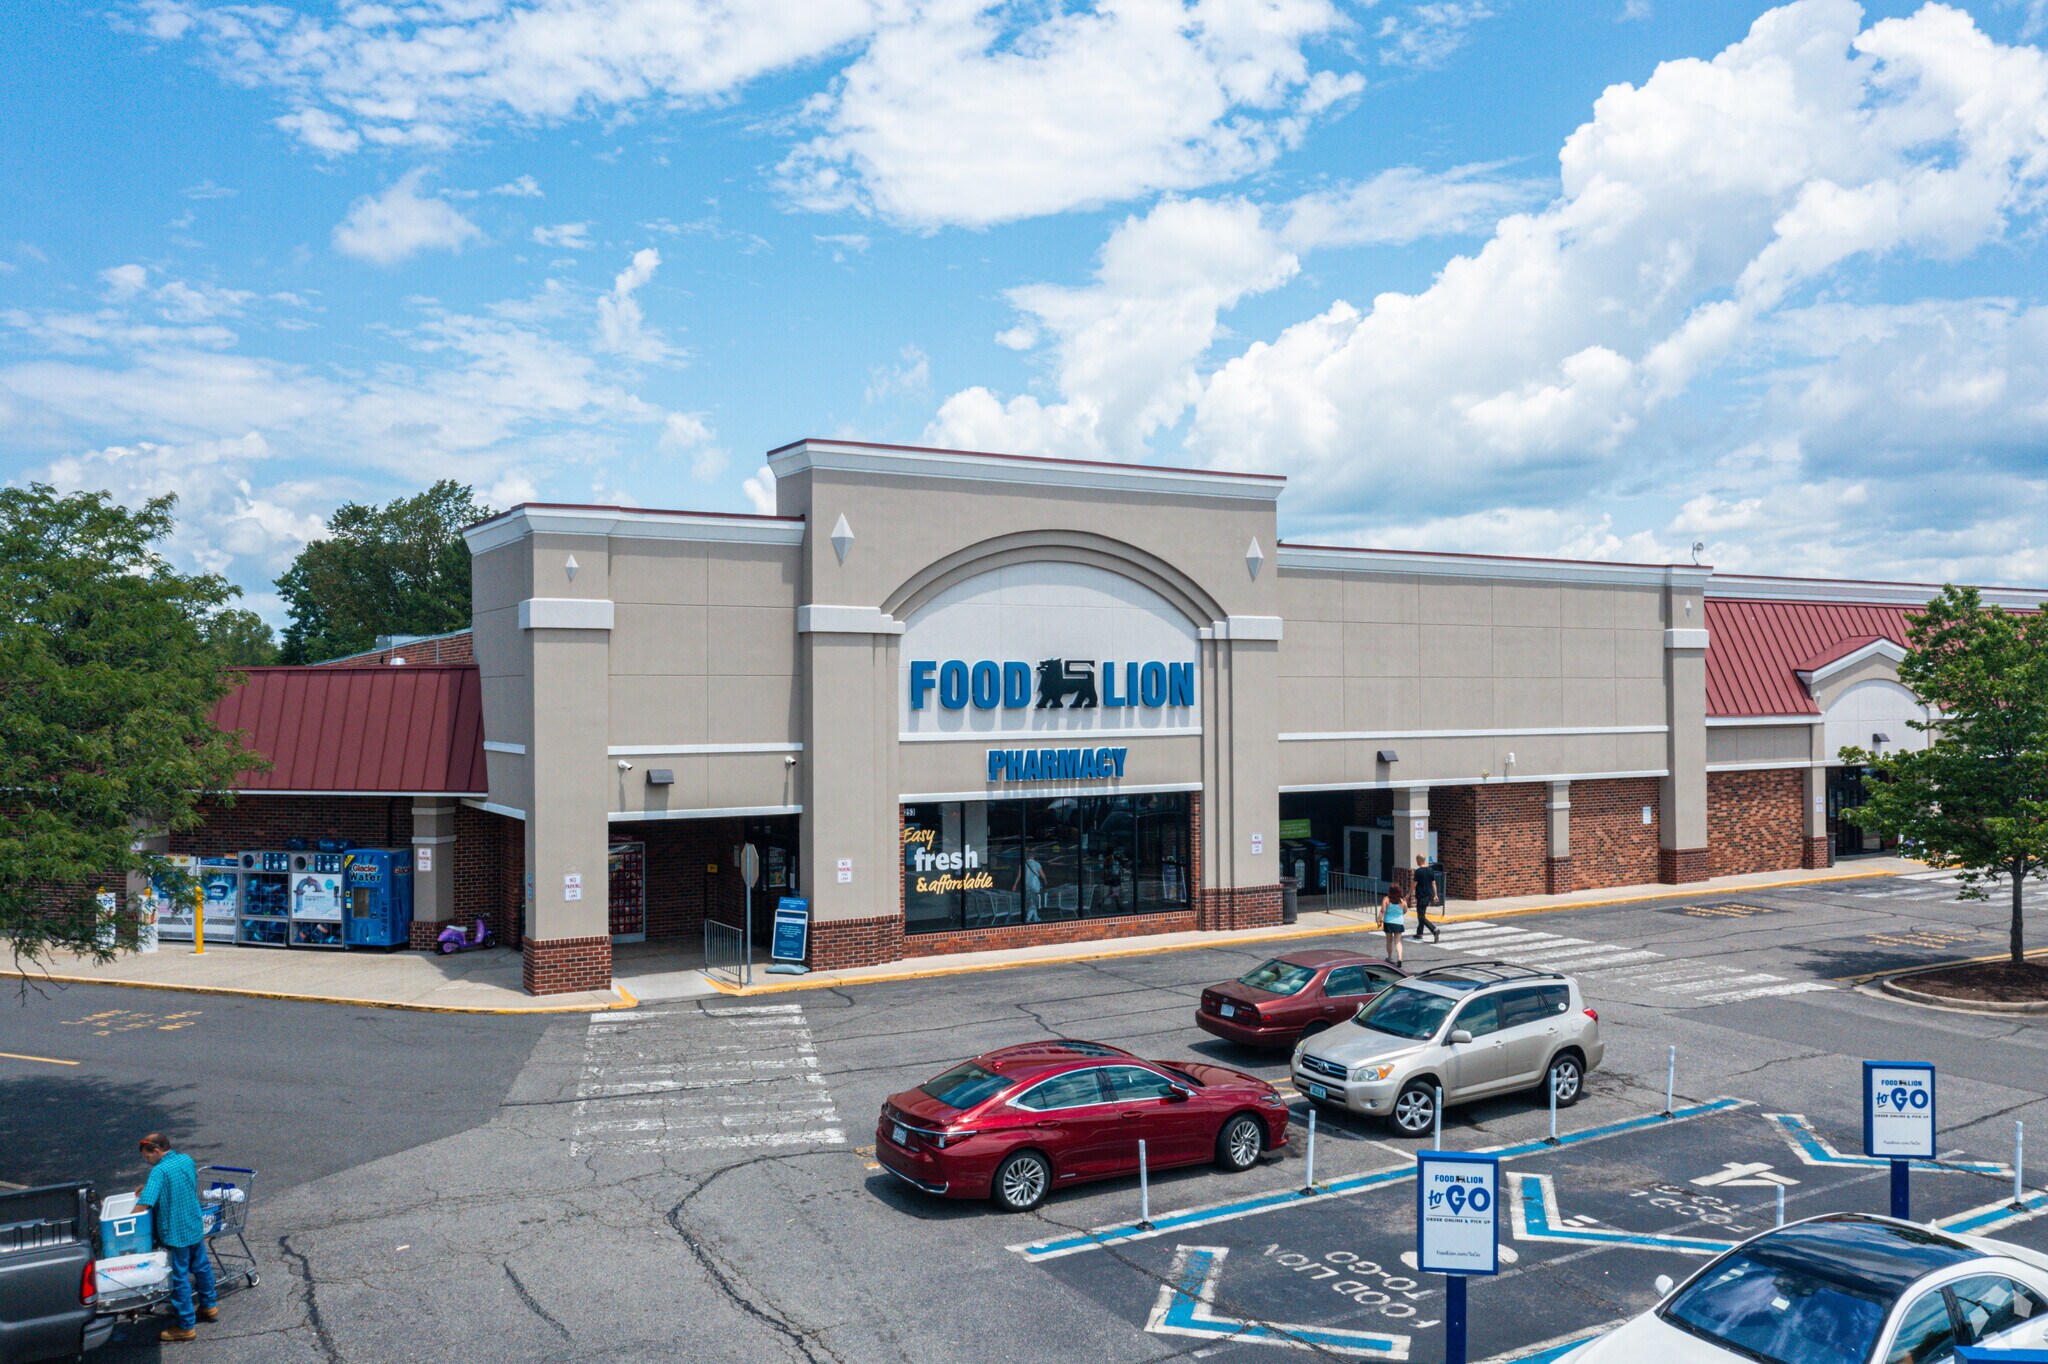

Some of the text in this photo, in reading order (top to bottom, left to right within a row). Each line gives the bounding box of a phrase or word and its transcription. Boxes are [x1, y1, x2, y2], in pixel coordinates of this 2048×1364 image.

[910, 659, 1195, 710] FOOD LION
[986, 746, 1128, 782] PHARMACY
[904, 827, 935, 850] Easy
[352, 864, 378, 873] Glacier
[914, 844, 978, 872] fresh
[350, 872, 381, 882] Water
[916, 876, 928, 892] &
[1876, 1087, 1929, 1112] to GO
[1434, 1174, 1455, 1183] FOOD
[1428, 1184, 1491, 1216] to GO
[1332, 1280, 1441, 1328] FOOD
